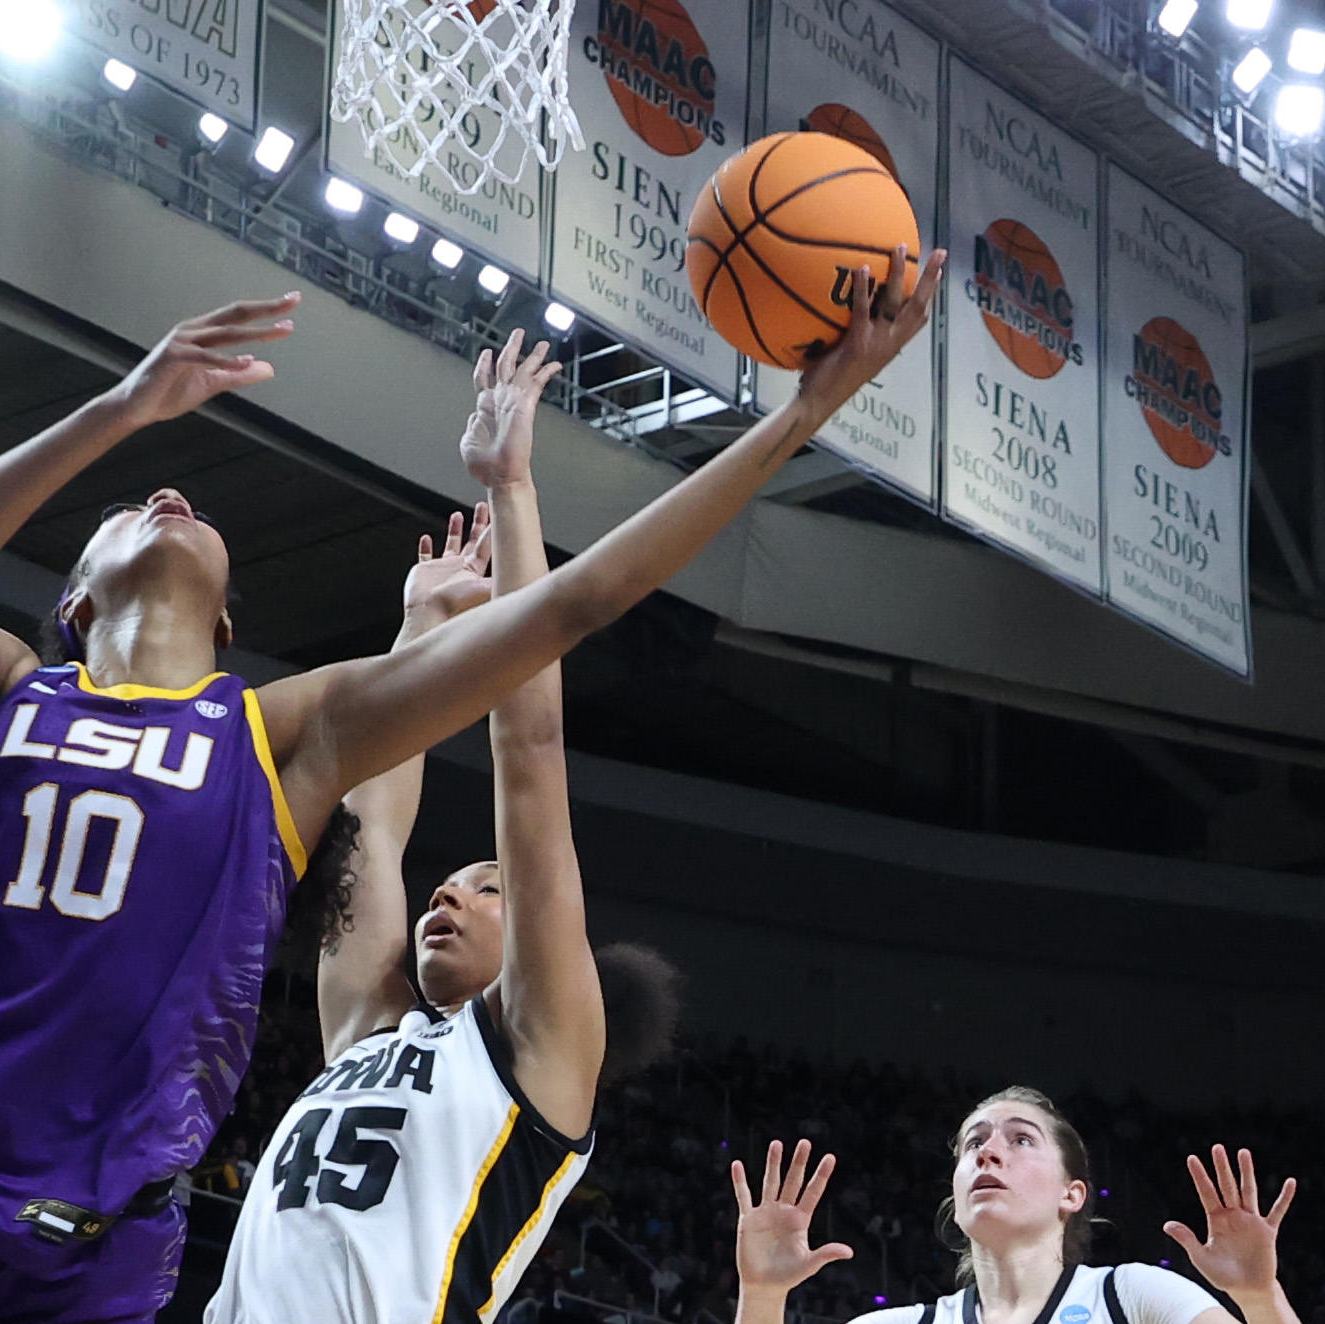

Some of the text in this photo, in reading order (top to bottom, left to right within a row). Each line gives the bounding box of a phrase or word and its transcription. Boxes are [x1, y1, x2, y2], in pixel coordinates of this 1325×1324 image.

[131, 24, 171, 63] OF
[184, 52, 241, 105] 1973
[583, 36, 725, 146] CHAMPIONS
[598, 0, 716, 100] MAAC
[779, 4, 930, 120] TOURNAMENT
[960, 124, 1090, 230] TOURNAMENT
[986, 100, 1063, 181] NCAA
[418, 174, 499, 235] Regional
[447, 151, 535, 220] ROUND
[592, 142, 682, 226] SIEN
[573, 226, 635, 280] FIRST
[614, 203, 686, 273] 1999
[975, 233, 1074, 328] MAAC
[1113, 227, 1236, 322] TOURNAMENT
[1141, 206, 1212, 280] NCAA
[587, 270, 706, 356] West Regional
[965, 277, 1084, 367] CHAMPIONS
[850, 391, 917, 439] OUND
[976, 372, 1073, 456] SIENA
[1125, 374, 1233, 458] CHAMPIONS
[1133, 334, 1222, 421] MAAC
[952, 445, 1097, 541] SECOND ROUND
[992, 427, 1058, 490] 2008
[1134, 463, 1221, 543] SIENA
[1150, 514, 1209, 572] 2009
[1113, 533, 1244, 623] SECOND ROUND
[0, 703, 214, 791] LSU
[3, 781, 145, 922] 10
[272, 1106, 408, 1212] 45
